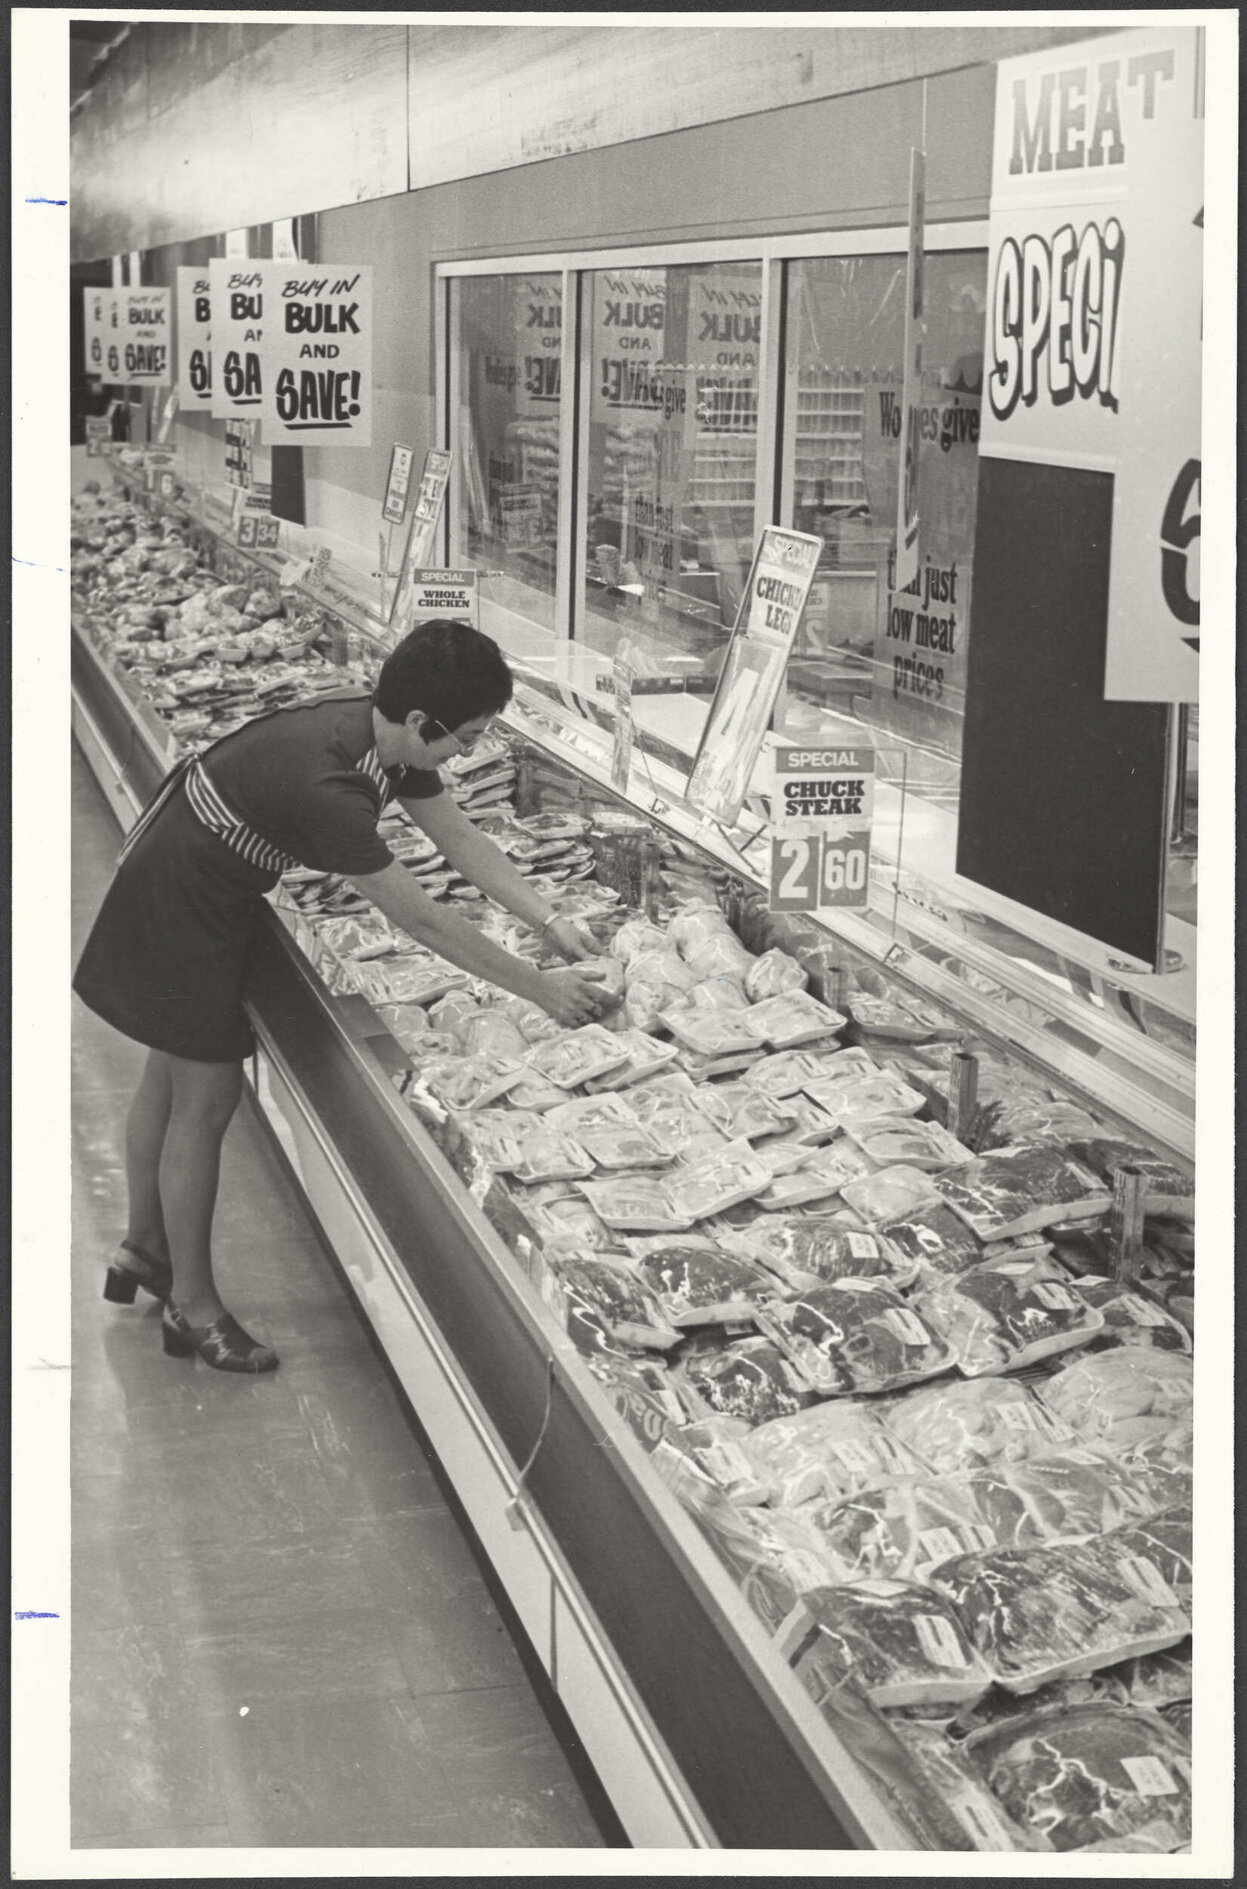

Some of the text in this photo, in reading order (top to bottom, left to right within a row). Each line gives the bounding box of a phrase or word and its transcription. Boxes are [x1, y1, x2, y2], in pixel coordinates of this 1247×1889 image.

[1009, 49, 1174, 175] MEAT
[281, 273, 361, 298] BUY IN
[128, 306, 166, 325] BULK
[285, 302, 361, 334] BULK
[299, 343, 341, 359] AND
[275, 367, 361, 421] SAVE!
[941, 397, 980, 453] give
[240, 519, 254, 543] 3
[421, 571, 465, 582] SPECIAL
[922, 554, 958, 611] just
[418, 599, 470, 608] CHICKEN
[423, 590, 466, 599] WHOLE
[886, 593, 957, 654] low meat
[893, 652, 944, 700] prices
[788, 751, 859, 768] SPECIAL
[784, 780, 865, 798] CHUCK
[785, 798, 862, 816] STEAK
[779, 840, 866, 899] 2 60
